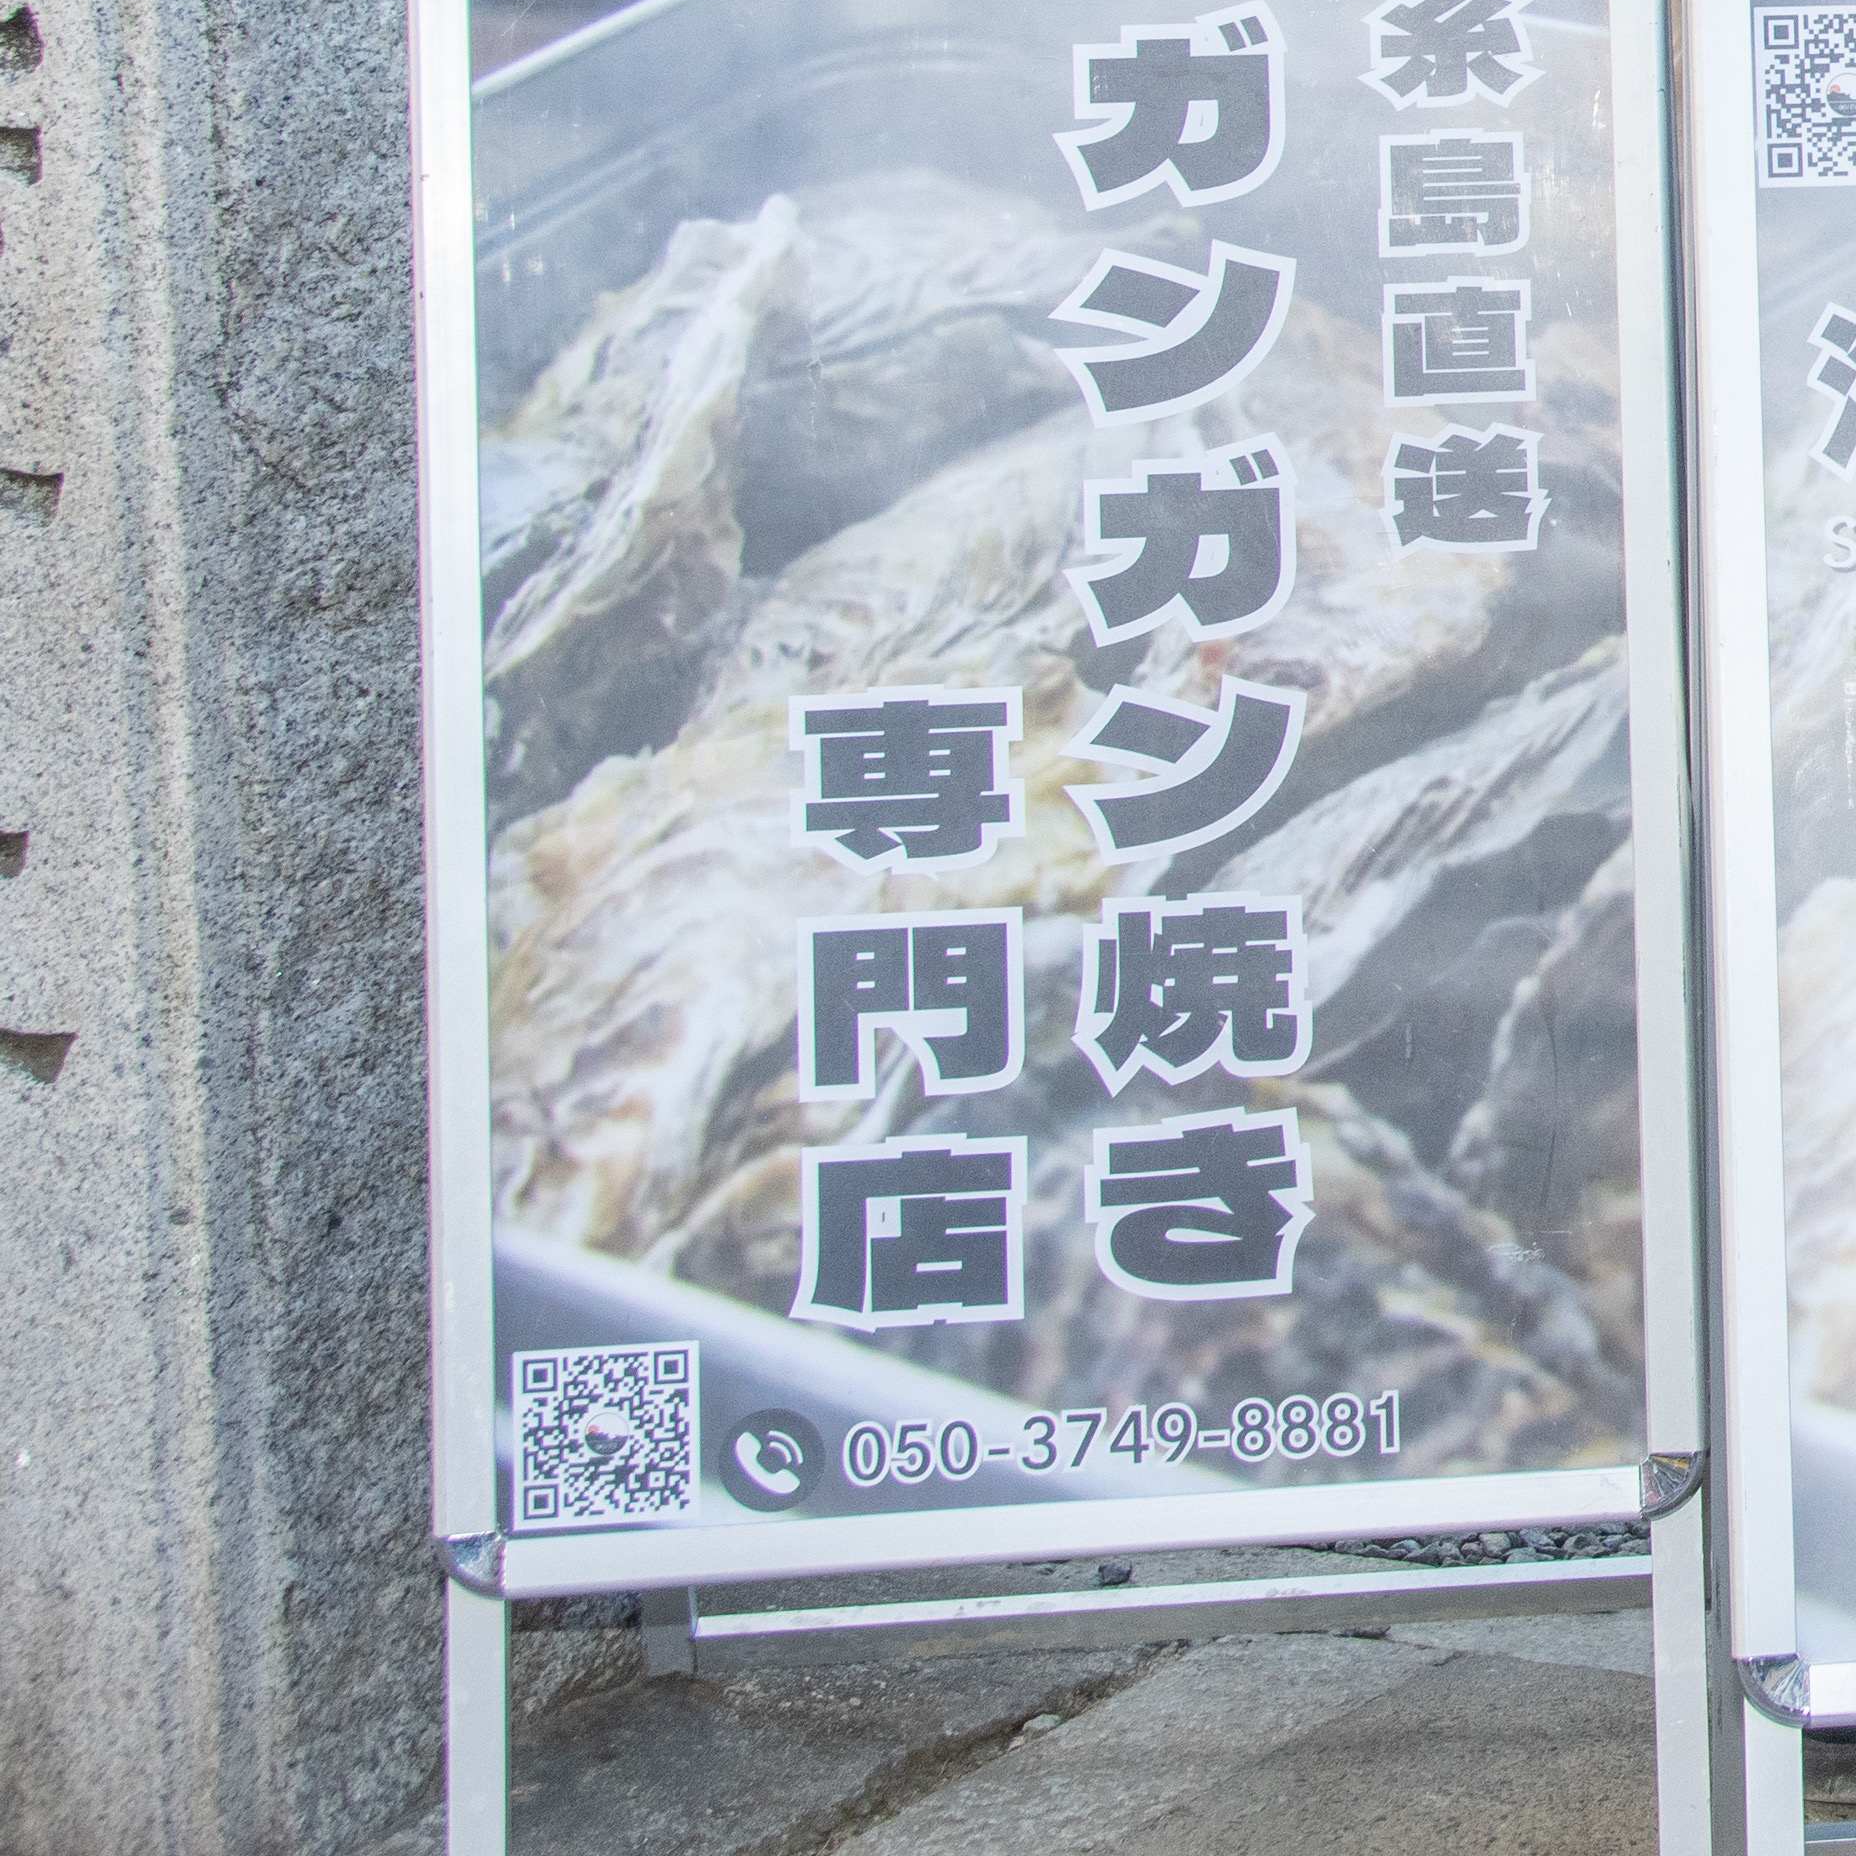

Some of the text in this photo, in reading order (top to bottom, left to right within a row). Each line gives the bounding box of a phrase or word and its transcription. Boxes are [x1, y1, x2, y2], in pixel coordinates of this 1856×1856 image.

[1050, 0, 1312, 1301] ガンガン焼き
[789, 684, 1027, 1333] 専門店
[842, 1389, 1400, 1486] 050-3749-8881
